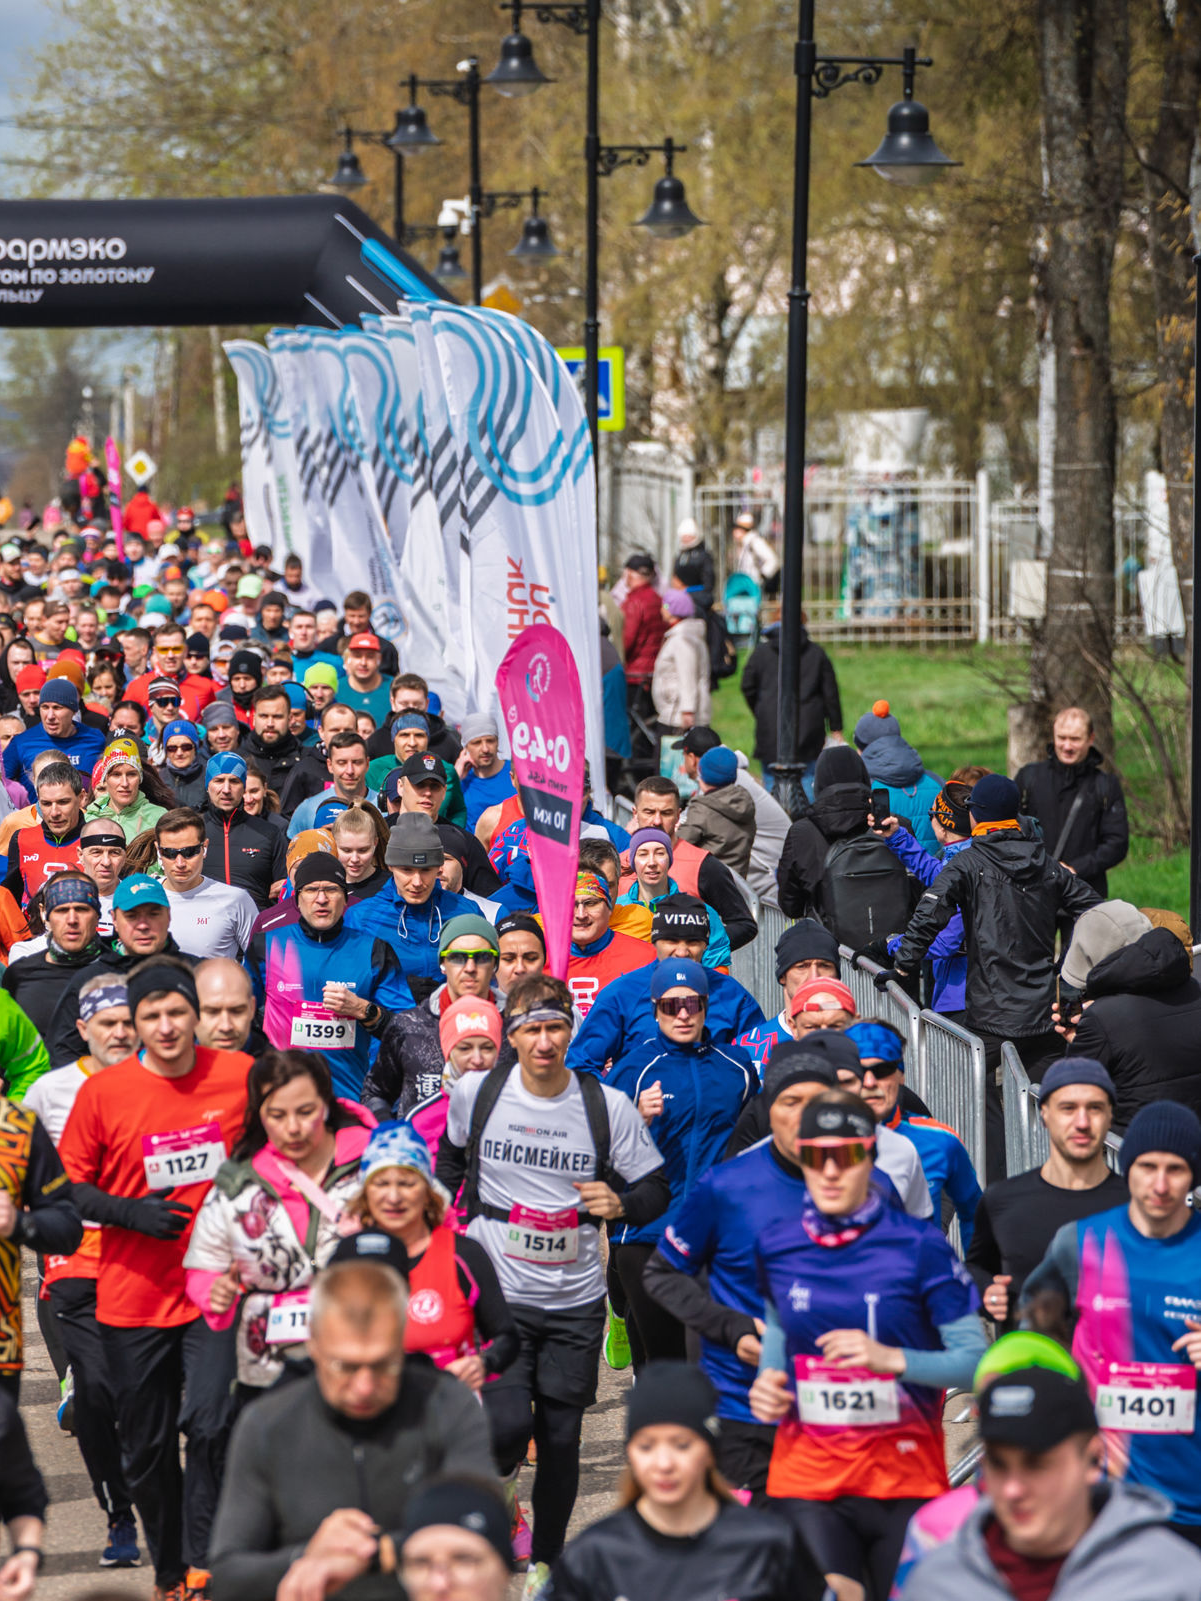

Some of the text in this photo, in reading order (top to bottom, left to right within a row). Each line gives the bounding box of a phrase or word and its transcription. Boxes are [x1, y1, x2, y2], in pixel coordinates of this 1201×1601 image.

[31, 268, 57, 284] ПО
[59, 266, 156, 284] ЗОЛОТОМУ
[305, 1024, 346, 1039] 1399
[165, 1152, 209, 1175] 1127
[483, 1138, 590, 1172] ПЕЙСМЕЙКЕР
[523, 1233, 566, 1252] 1514
[820, 1390, 876, 1411] 1621
[1117, 1395, 1175, 1417] 1401
